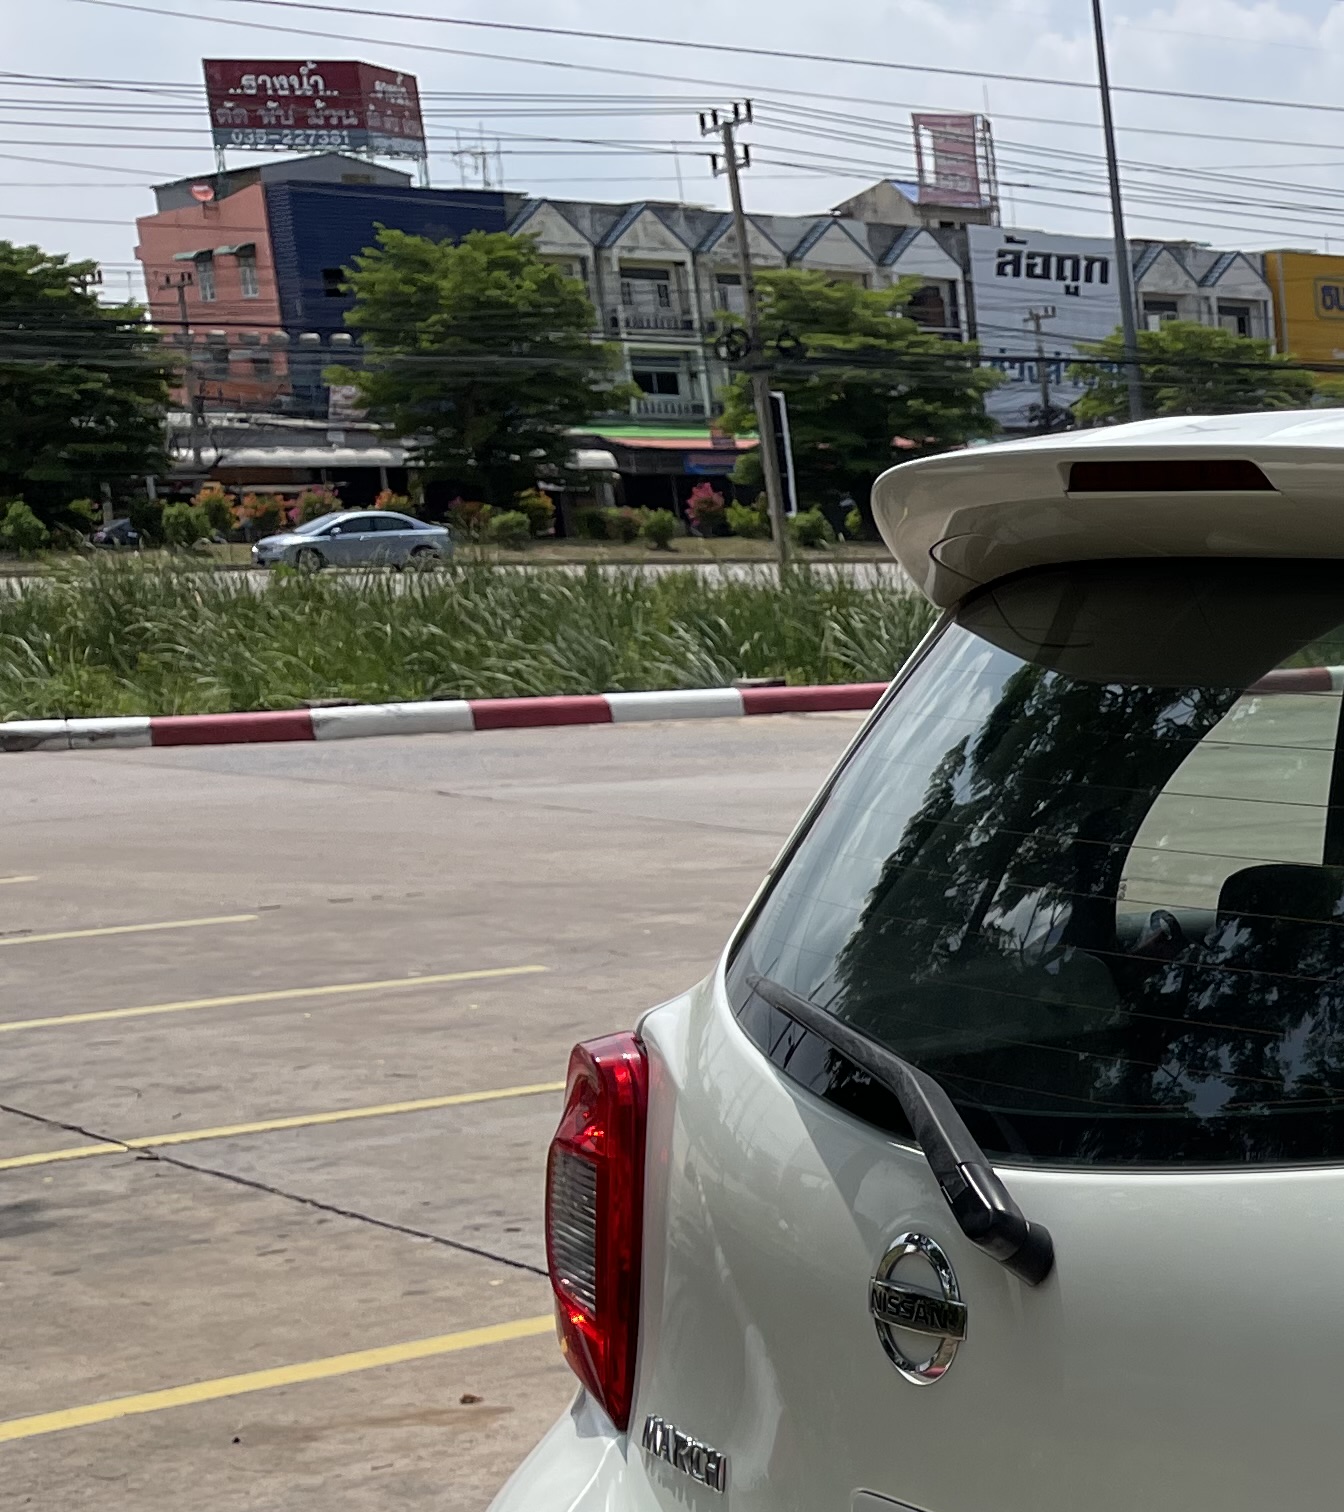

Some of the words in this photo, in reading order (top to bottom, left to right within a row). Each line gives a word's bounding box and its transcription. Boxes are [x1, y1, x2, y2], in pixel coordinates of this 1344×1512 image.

[996, 235, 1110, 297] ล้อถูก
[871, 1289, 951, 1331] NISSAN
[642, 1413, 727, 1494] MARCH
